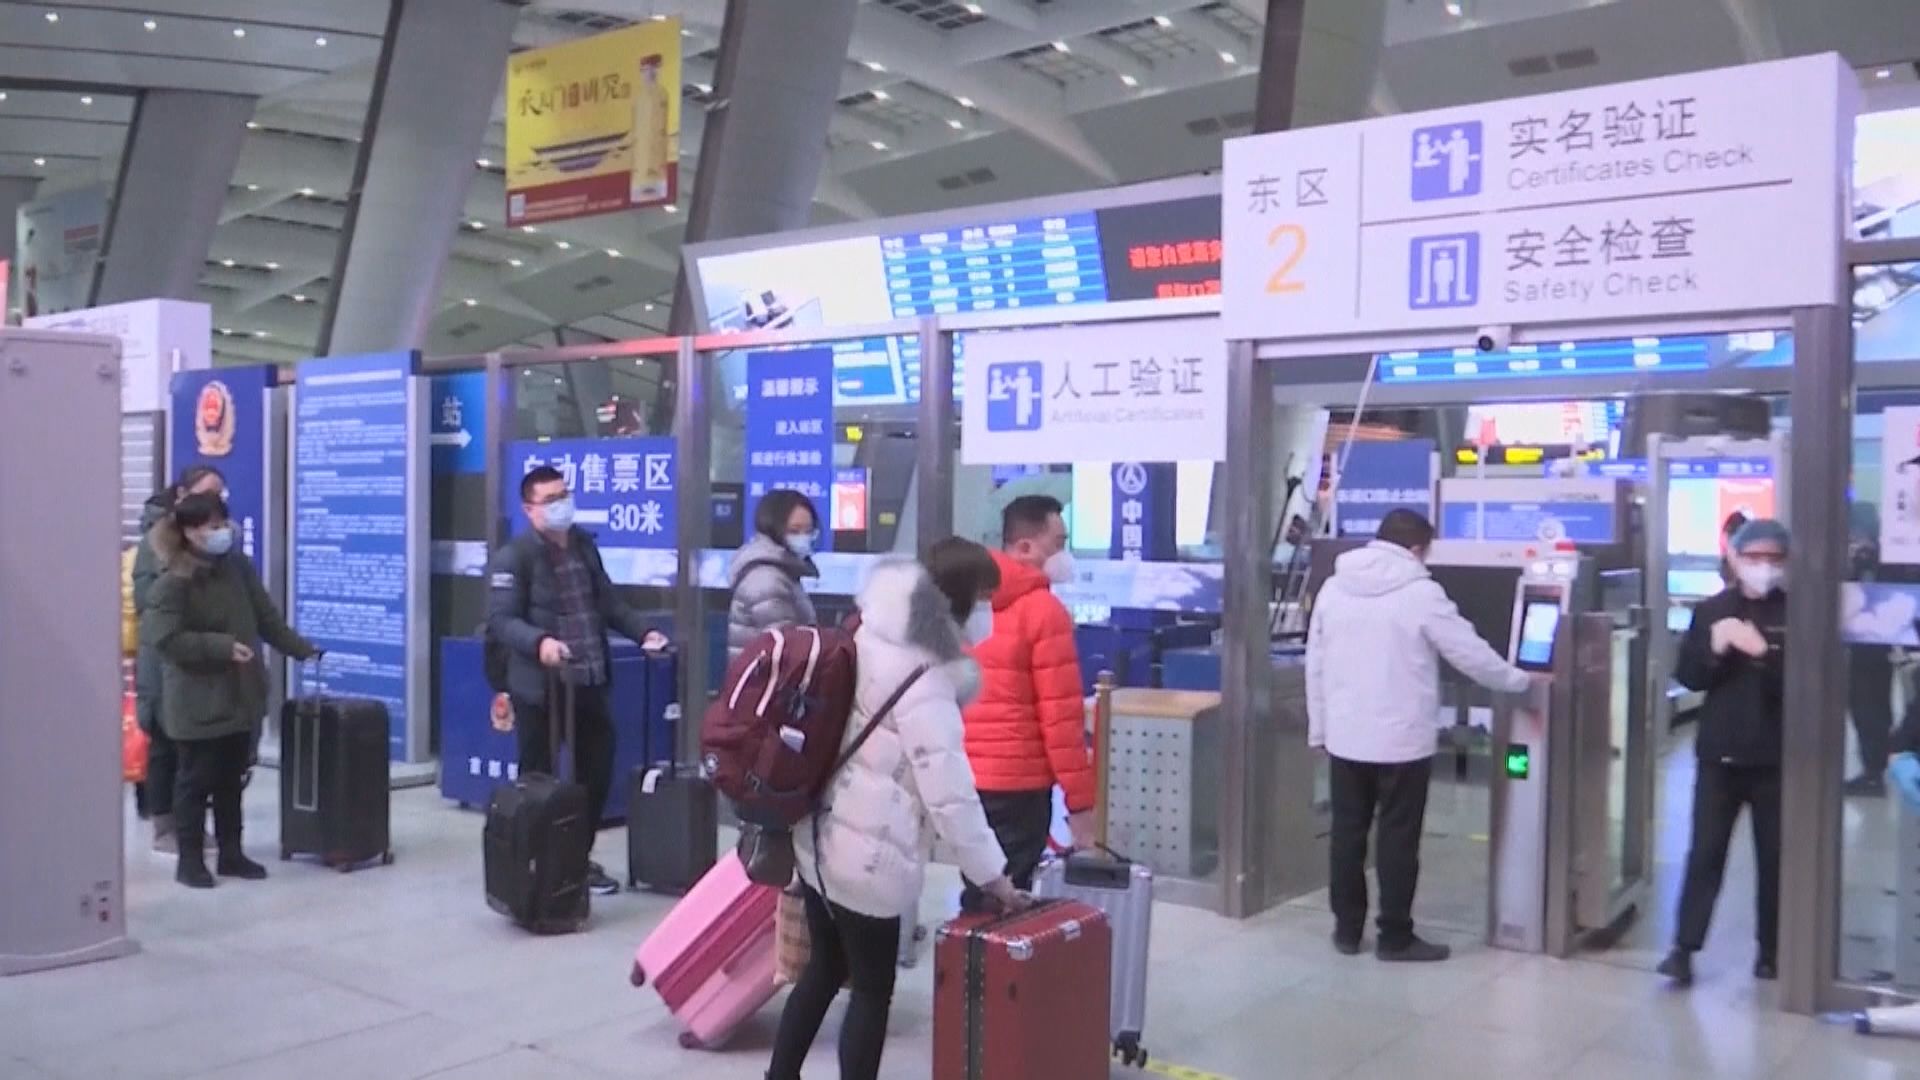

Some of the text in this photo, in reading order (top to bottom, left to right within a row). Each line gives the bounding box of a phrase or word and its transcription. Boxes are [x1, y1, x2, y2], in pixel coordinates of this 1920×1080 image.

[1509, 97, 1697, 159] 实名验证
[1248, 167, 1329, 213] 东区
[1507, 144, 1753, 190] Certificates Check
[1265, 223, 1308, 294] 2
[1505, 216, 1696, 271] 安全检查
[1504, 268, 1698, 303] Safety Check
[1052, 357, 1204, 399] 人工验证
[441, 396, 464, 427] 站
[609, 500, 664, 535] 30米
